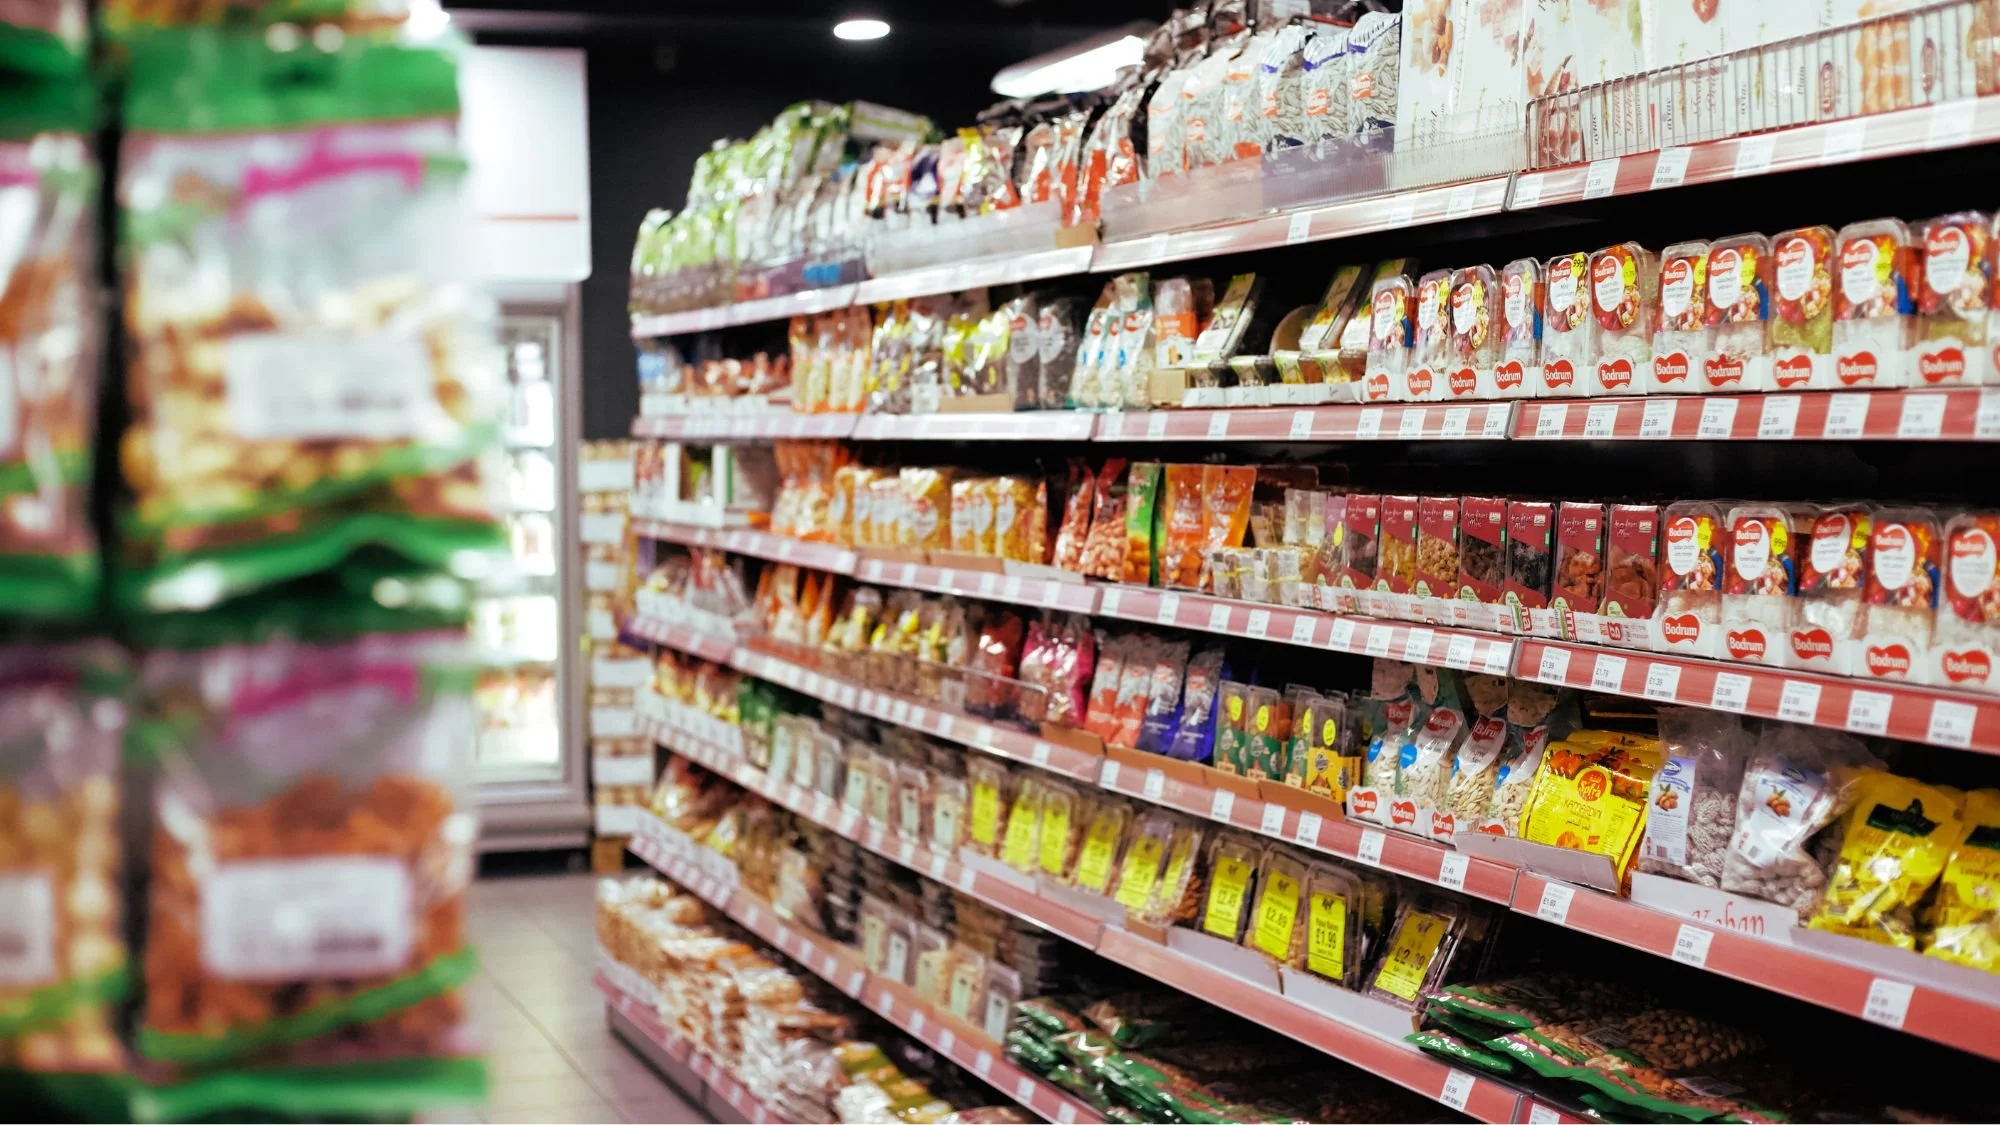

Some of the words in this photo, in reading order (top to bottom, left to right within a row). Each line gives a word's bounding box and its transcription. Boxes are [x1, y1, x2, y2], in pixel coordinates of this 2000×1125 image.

[1551, 268, 1571, 277] Bodrum
[1573, 261, 1585, 271] 99p
[1594, 266, 1617, 278] Bodrum
[1656, 363, 1686, 376] Bodrum
[1706, 365, 1742, 378] Bodrum
[1776, 366, 1810, 378] Bodrum
[1840, 362, 1876, 375] Bodrum
[1923, 360, 1962, 375] Bodrum
[1496, 371, 1522, 383] Bodrum
[1544, 369, 1573, 382] Bodrum
[1601, 368, 1631, 381] Bodrum
[1408, 379, 1431, 390] Bodrum
[1450, 377, 1475, 390] Bodrum
[1669, 527, 1694, 538] Bodrum
[1665, 623, 1698, 637] Bodrum
[1729, 638, 1764, 652] Bodrum
[1794, 639, 1831, 654] Bodrum
[1869, 653, 1908, 670] Bodrum
[1946, 658, 1988, 676] Bodrum
[1315, 927, 1337, 949] £1.99
